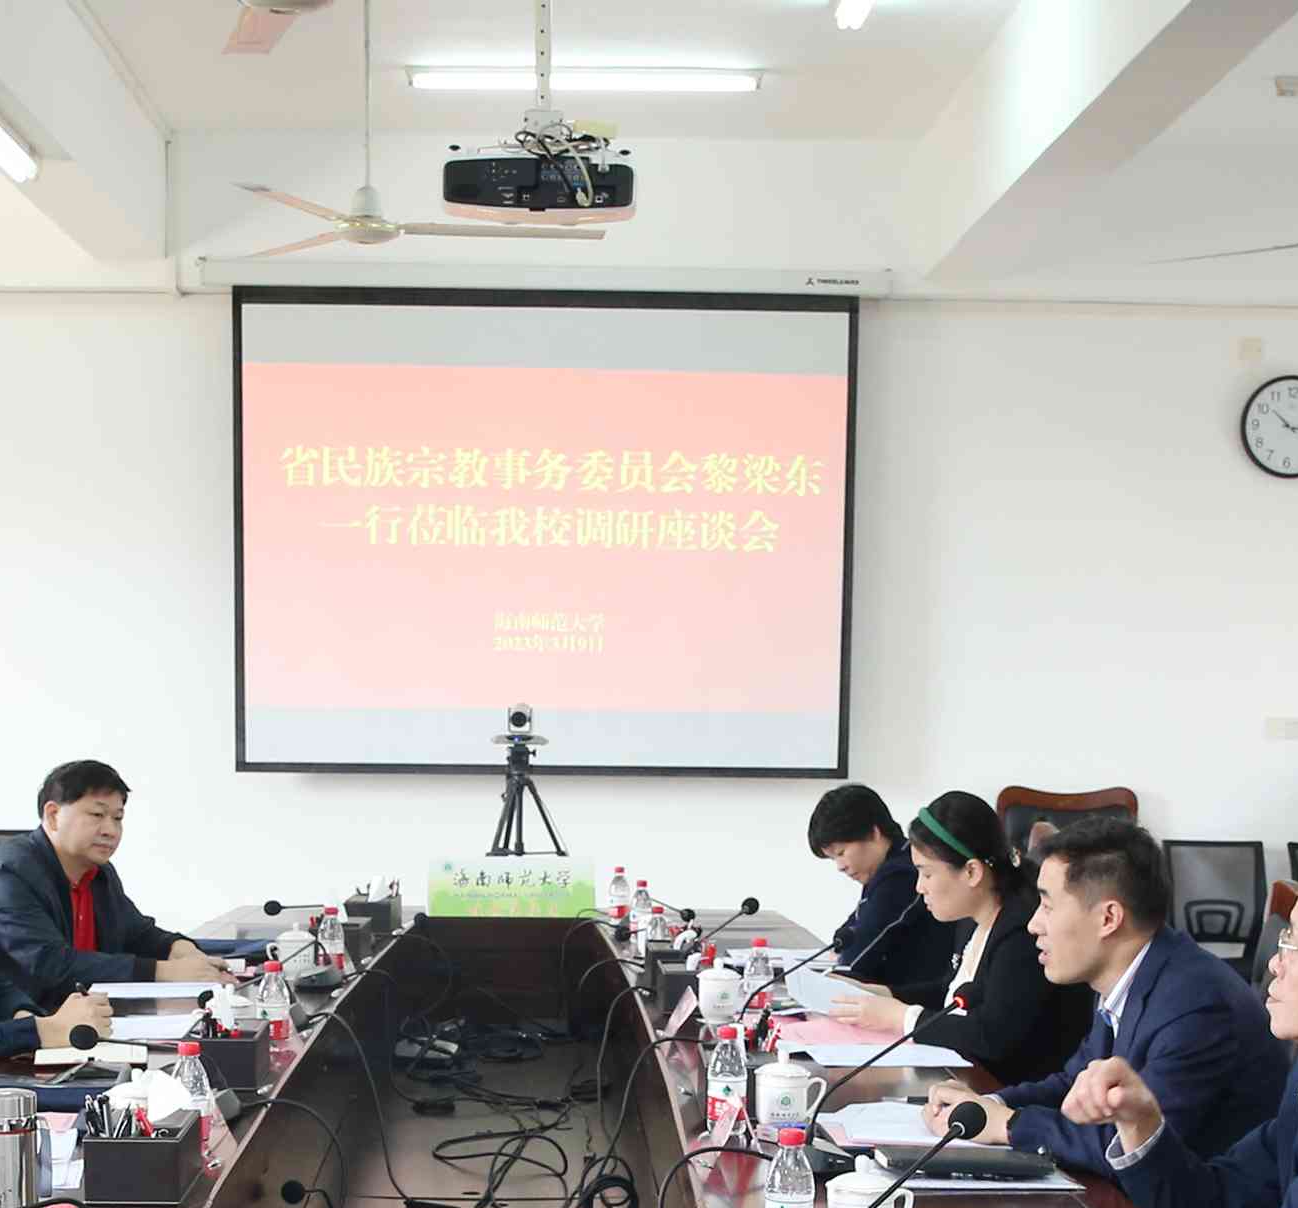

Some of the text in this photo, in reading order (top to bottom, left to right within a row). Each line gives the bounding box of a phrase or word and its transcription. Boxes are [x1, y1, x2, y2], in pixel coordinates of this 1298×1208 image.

[280, 445, 824, 497] 省民族宗教事务委员会黎梁东
[320, 504, 780, 553] 一行莅临我校调研座谈会
